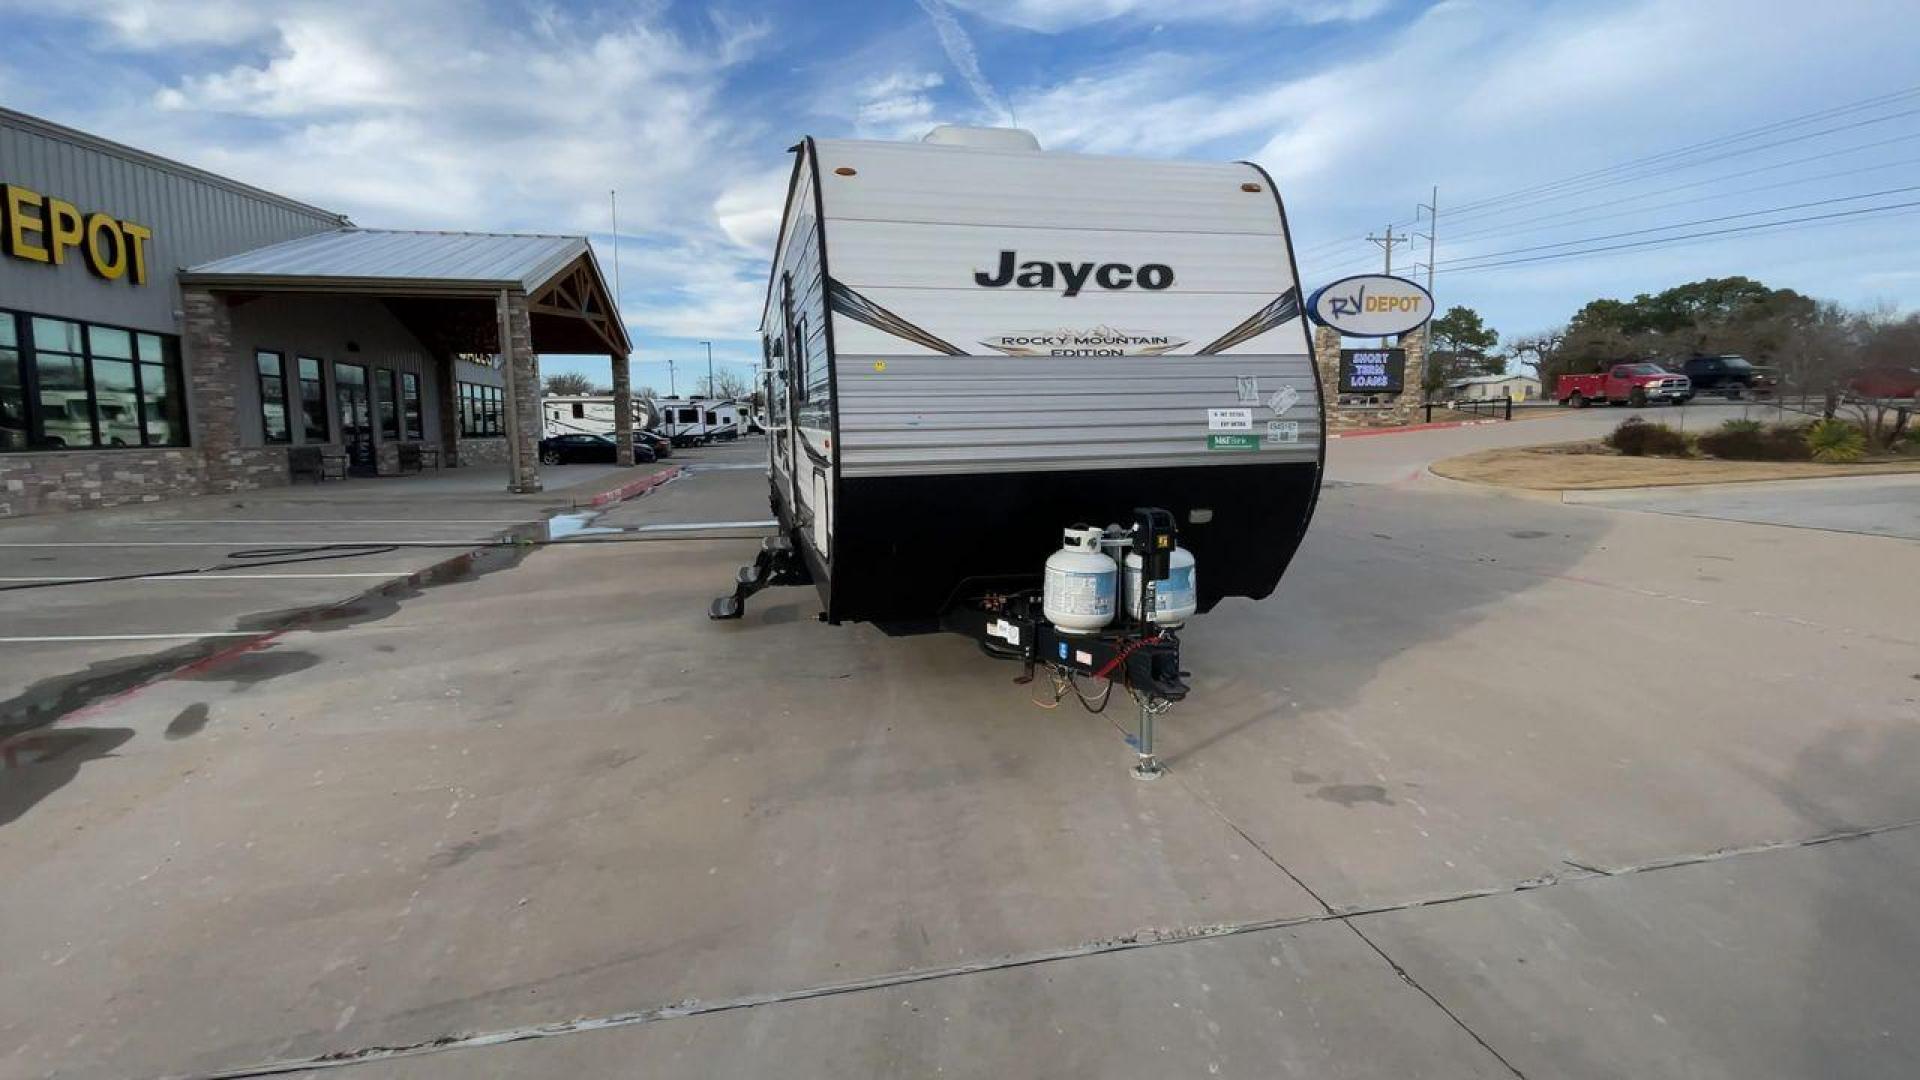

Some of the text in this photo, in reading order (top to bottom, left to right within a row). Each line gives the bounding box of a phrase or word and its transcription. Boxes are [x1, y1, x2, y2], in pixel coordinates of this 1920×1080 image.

[0, 184, 152, 288] EPOT
[974, 250, 1174, 297] Jayco
[1328, 284, 1422, 319] RV DEPOT
[1001, 336, 1169, 345] ROCKY MOUNTAIN
[1050, 348, 1125, 357] EDITION
[1352, 353, 1389, 364] SHORT
[1355, 365, 1386, 375] TERM
[1351, 376, 1388, 387] LOANS
